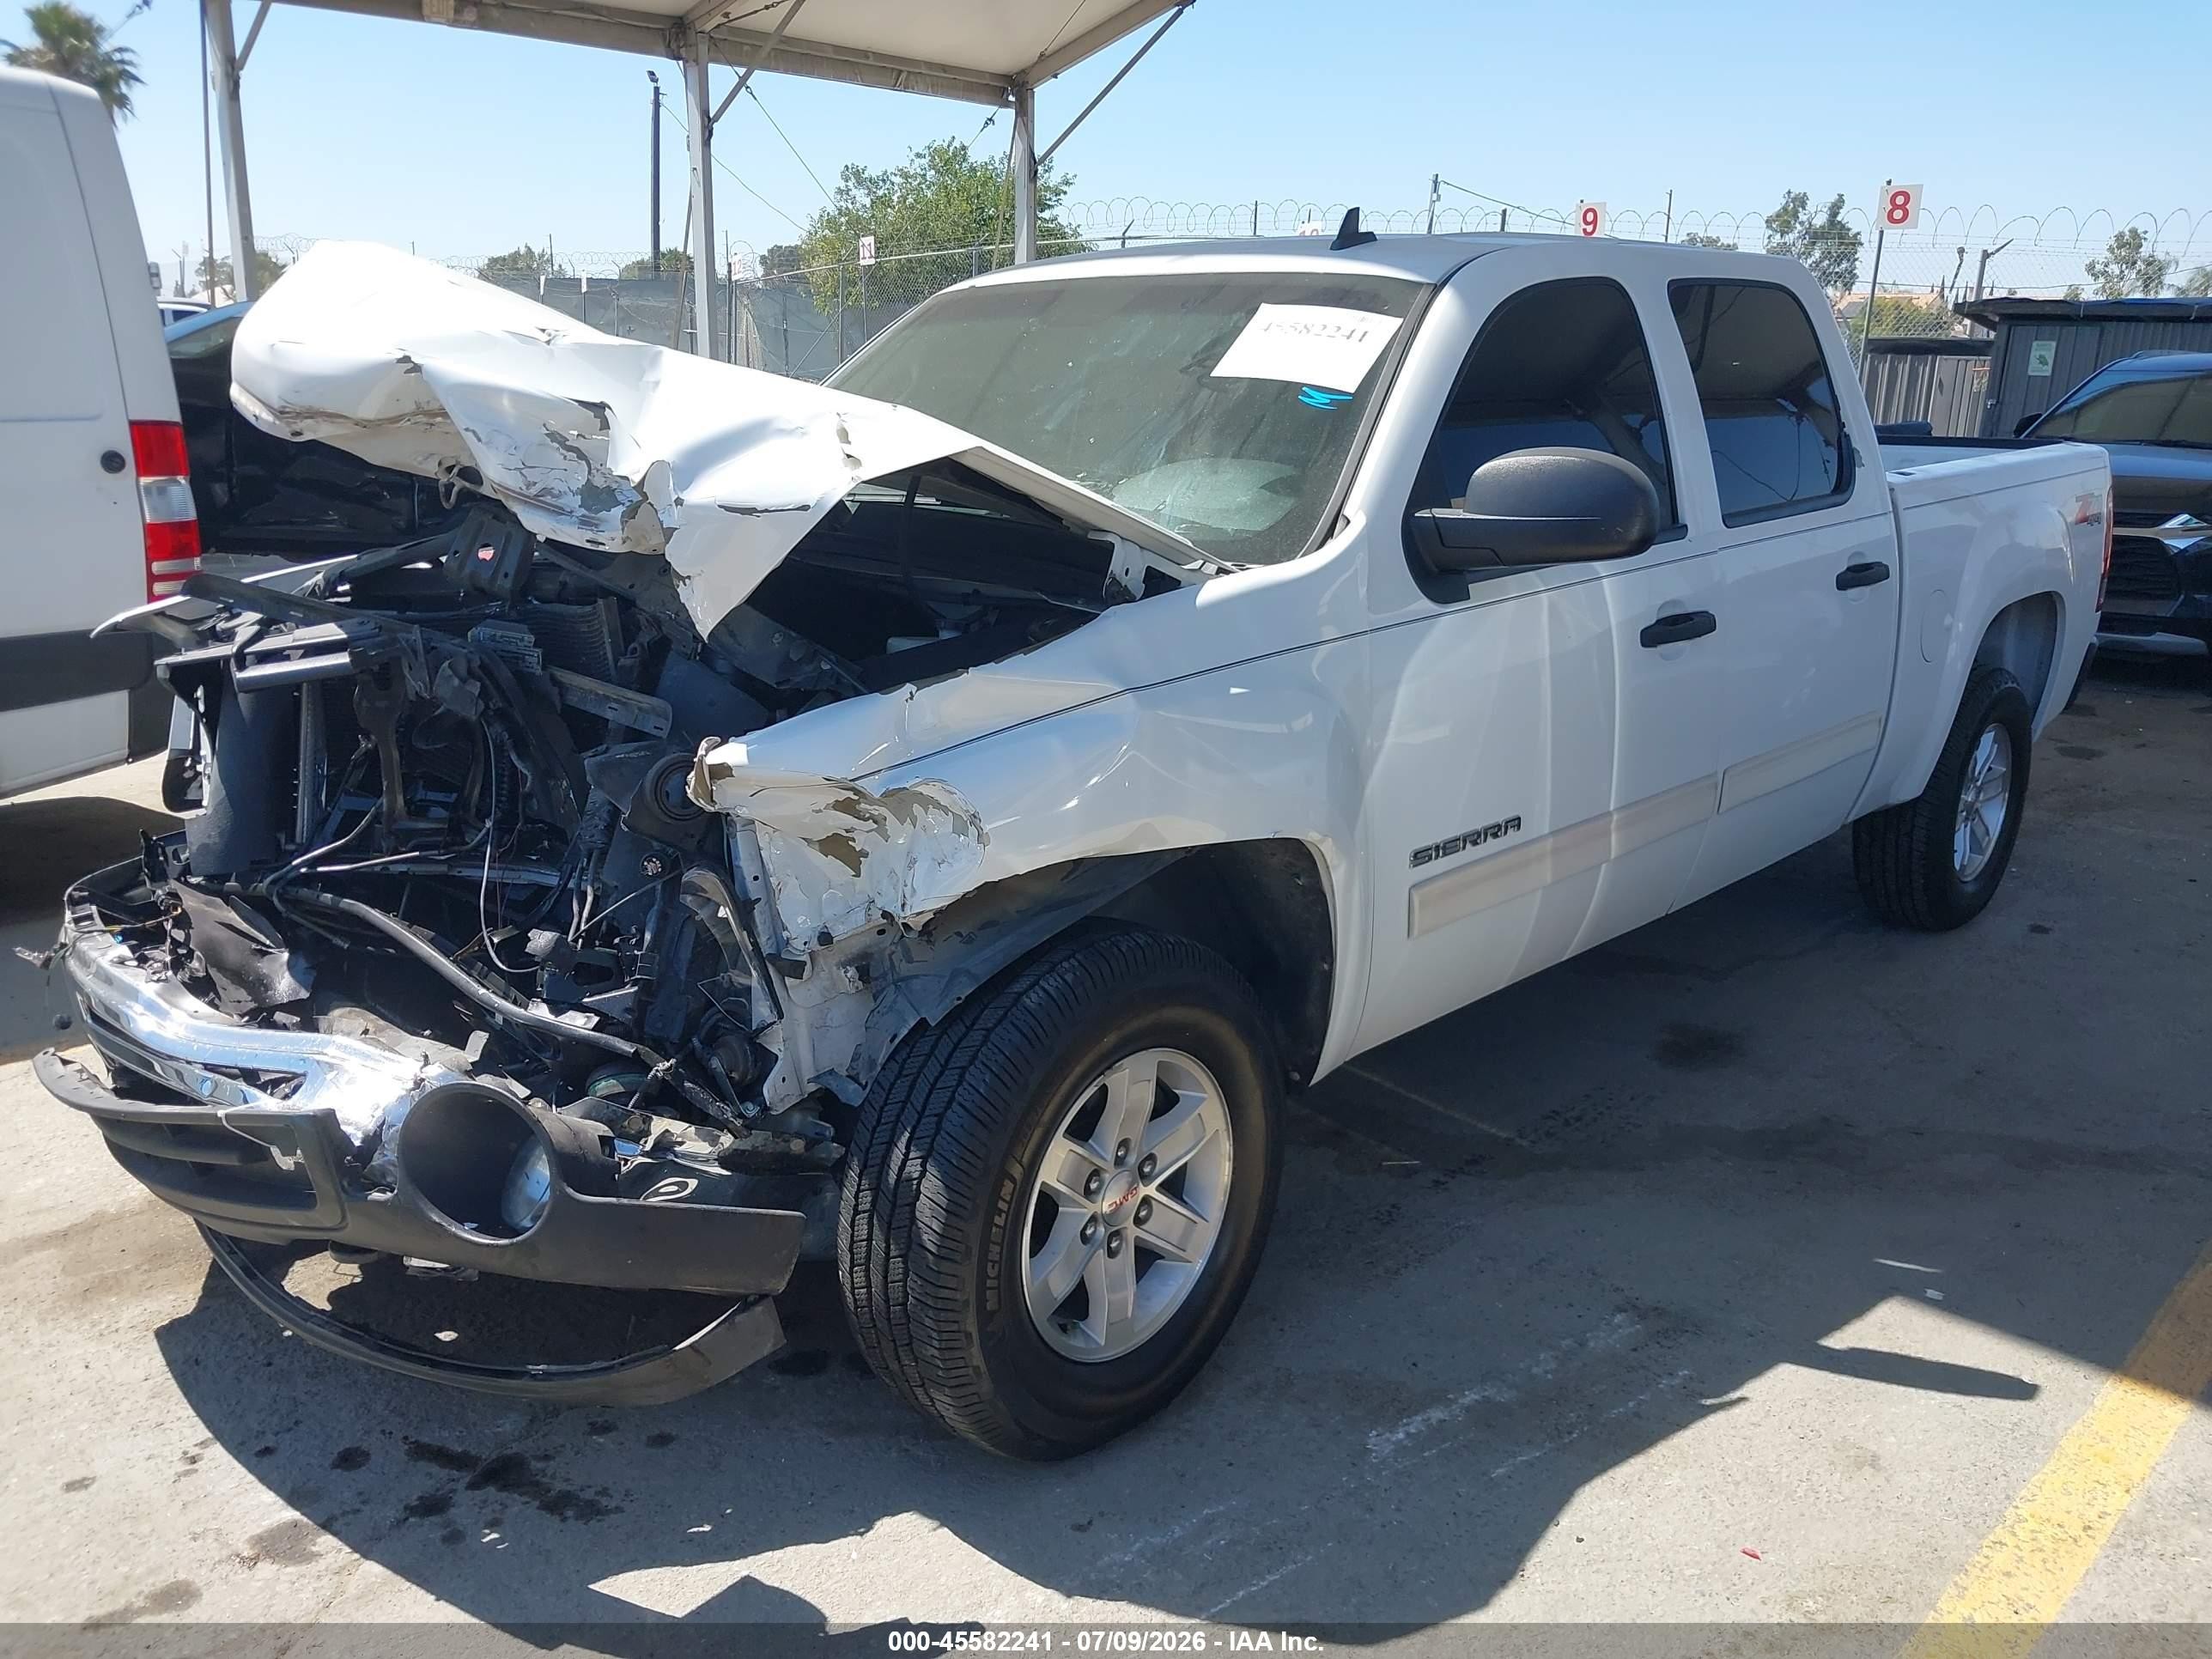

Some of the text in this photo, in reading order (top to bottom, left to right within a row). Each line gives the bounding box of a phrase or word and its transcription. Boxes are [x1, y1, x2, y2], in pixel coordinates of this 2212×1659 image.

[1583, 207, 1598, 236] 9
[1887, 190, 1911, 224] 8
[860, 241, 873, 260] 11
[1409, 814, 1522, 869] SIERRA
[1106, 1184, 1139, 1213] GMC
[985, 1177, 1016, 1312] MICHELIN
